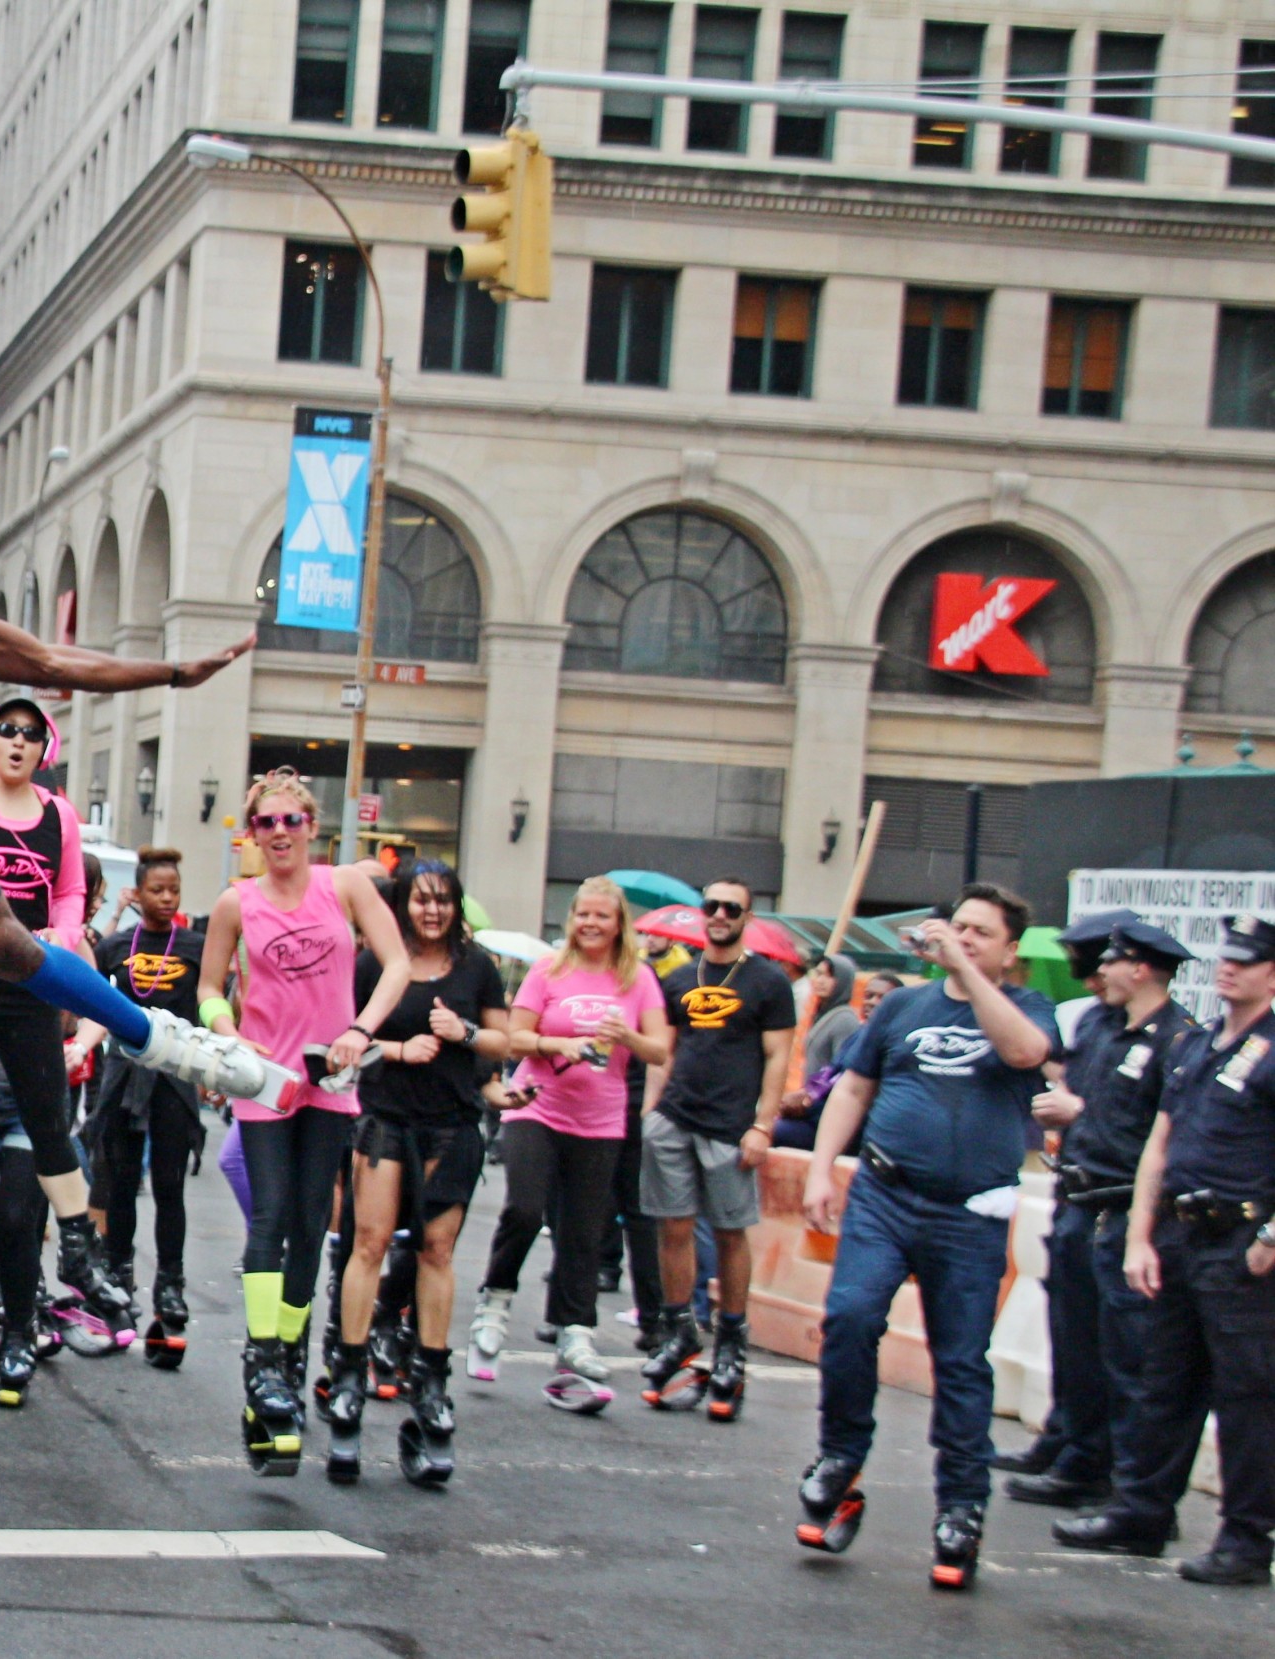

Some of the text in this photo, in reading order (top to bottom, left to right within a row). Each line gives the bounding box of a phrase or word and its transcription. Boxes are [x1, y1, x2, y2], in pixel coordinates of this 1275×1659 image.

[379, 664, 417, 684] 4 AVE
[1079, 877, 1094, 904] TO
[1097, 878, 1195, 907] ANONYMOUSLY
[1200, 880, 1253, 908] REPORT
